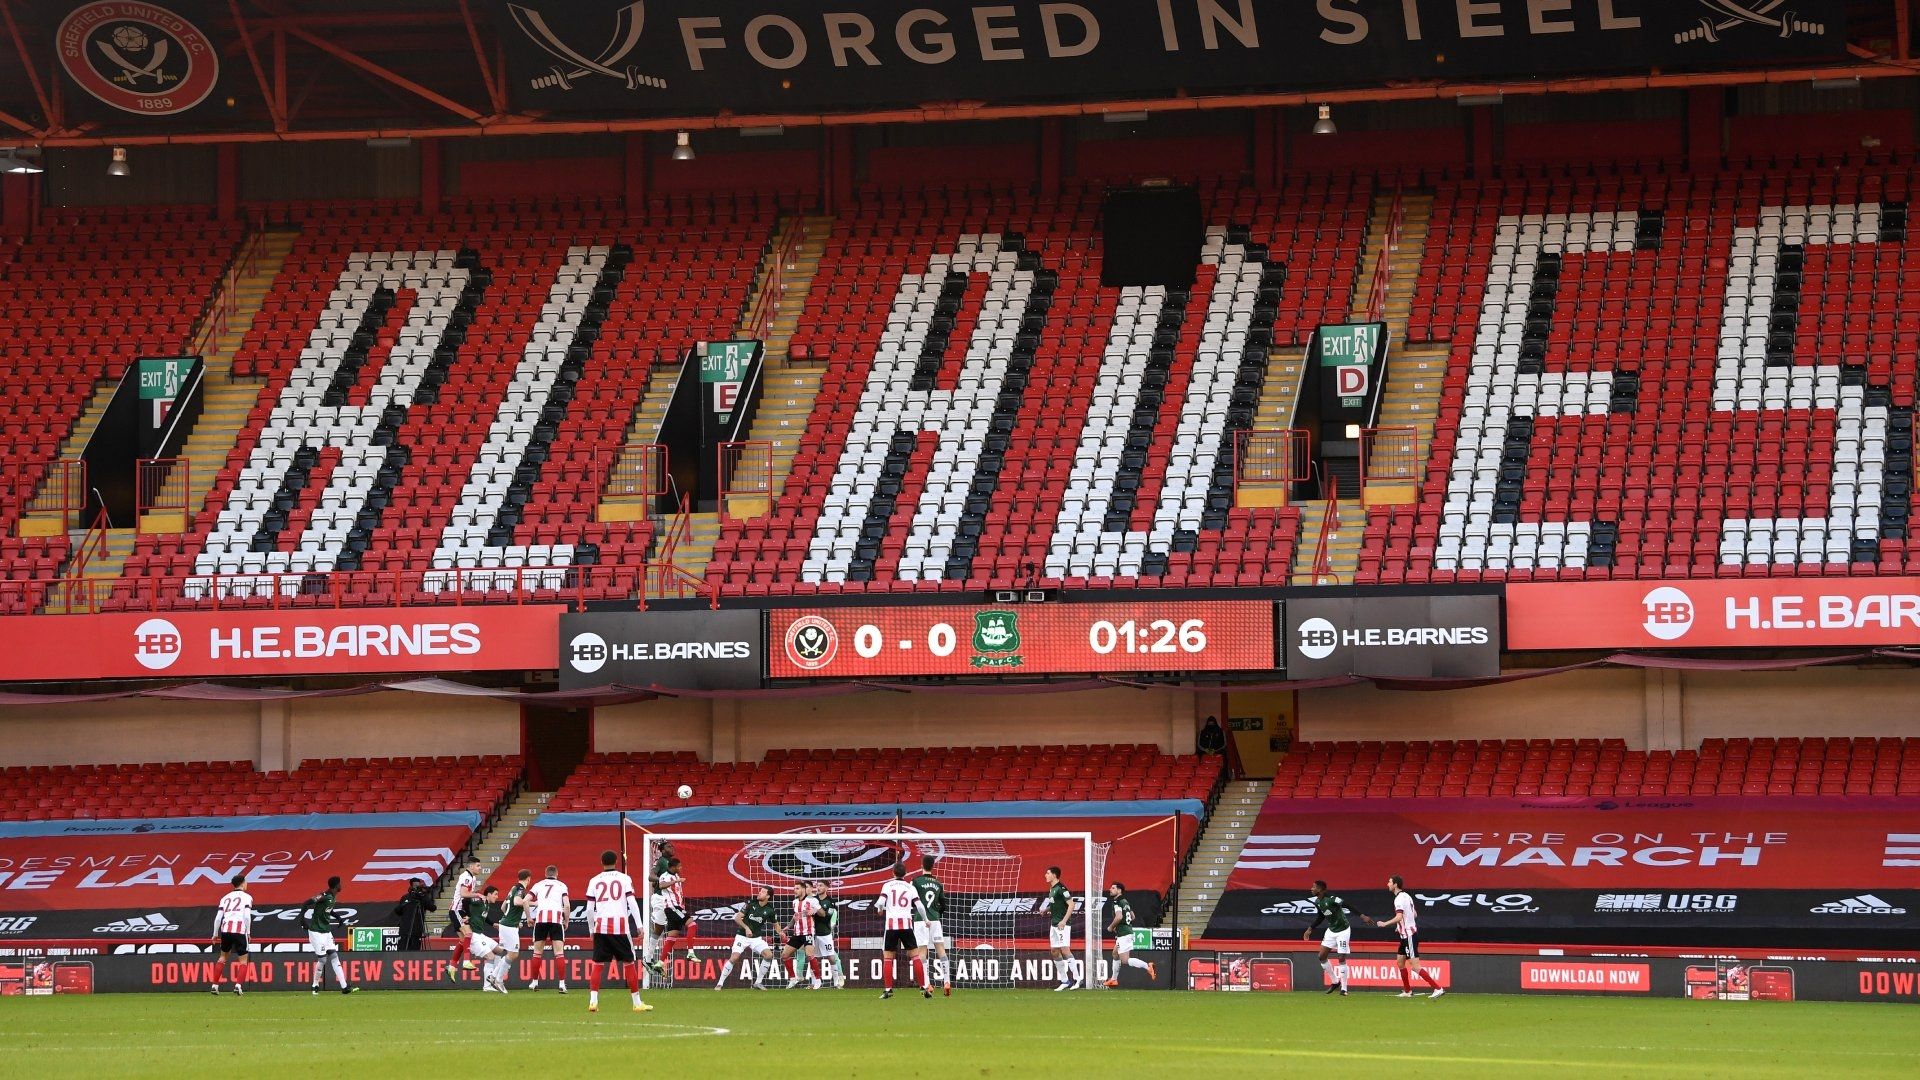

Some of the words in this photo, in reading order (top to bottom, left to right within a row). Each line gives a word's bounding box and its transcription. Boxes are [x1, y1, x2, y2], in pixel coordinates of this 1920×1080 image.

[65, 6, 115, 58] SHEFFIELD
[121, 5, 183, 32] UNITED
[183, 33, 205, 56] F.C.
[678, 3, 1101, 71] FORGED
[1156, 0, 1261, 51] IN
[1319, 0, 1642, 45] STEEL
[137, 97, 173, 109] 1889
[1322, 336, 1352, 356] EXIT
[701, 355, 723, 371] EXIT
[141, 371, 163, 387] EXIT
[1339, 368, 1365, 393] D
[719, 385, 737, 409] E
[1343, 398, 1361, 406] EXIT
[720, 415, 730, 423] EX
[209, 622, 481, 659] H.E.BARNES
[854, 624, 883, 658] 0
[927, 623, 957, 657] 0
[1089, 619, 1206, 654] 01:26
[1342, 626, 1488, 645] H.E.BARNES
[612, 639, 750, 662] H.E.BARNES
[63, 824, 126, 833] Premier
[160, 823, 225, 832] League
[1413, 832, 1566, 845] WE'RE
[1591, 832, 1663, 845] ON
[1690, 832, 1788, 844] THE
[201, 849, 334, 864] FROM
[1426, 846, 1762, 867] MARCH
[75, 864, 297, 889] LANE
[544, 884, 554, 899] 7
[594, 879, 623, 903] 20
[890, 889, 909, 908] 16
[924, 890, 936, 909] 9
[224, 897, 243, 913] 22
[1414, 893, 1533, 907] YELO
[1667, 894, 1738, 909] USG
[1260, 904, 1350, 914] adids
[1809, 905, 1907, 914] adidas
[92, 923, 180, 933] adidas
[956, 958, 999, 980] AND
[1530, 968, 1604, 984] DOWNLOAD
[1609, 970, 1641, 984] NOW
